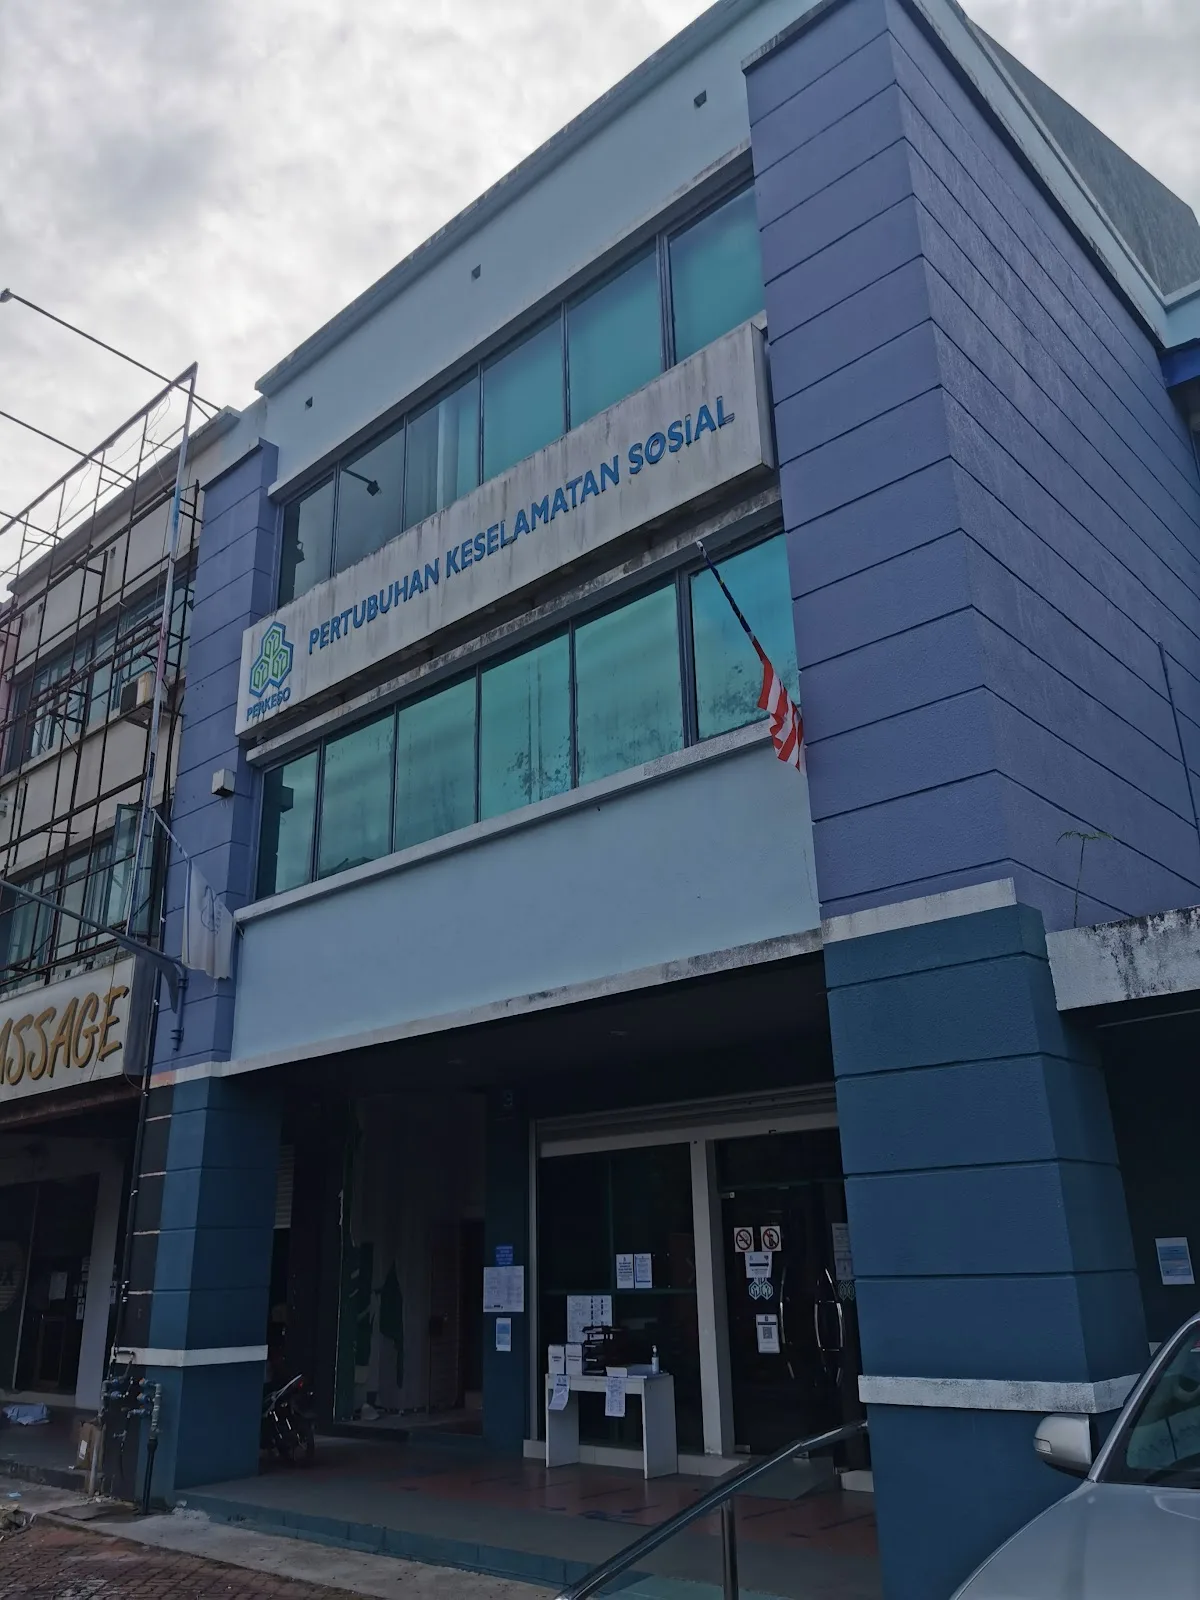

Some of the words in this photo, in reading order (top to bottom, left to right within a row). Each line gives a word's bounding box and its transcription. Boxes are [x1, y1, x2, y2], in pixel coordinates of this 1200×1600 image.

[309, 557, 439, 655] PERTUBUHAN
[446, 455, 620, 578] KESELAMATAN
[628, 396, 735, 475] SOSIAL
[247, 687, 291, 721] PERKESO
